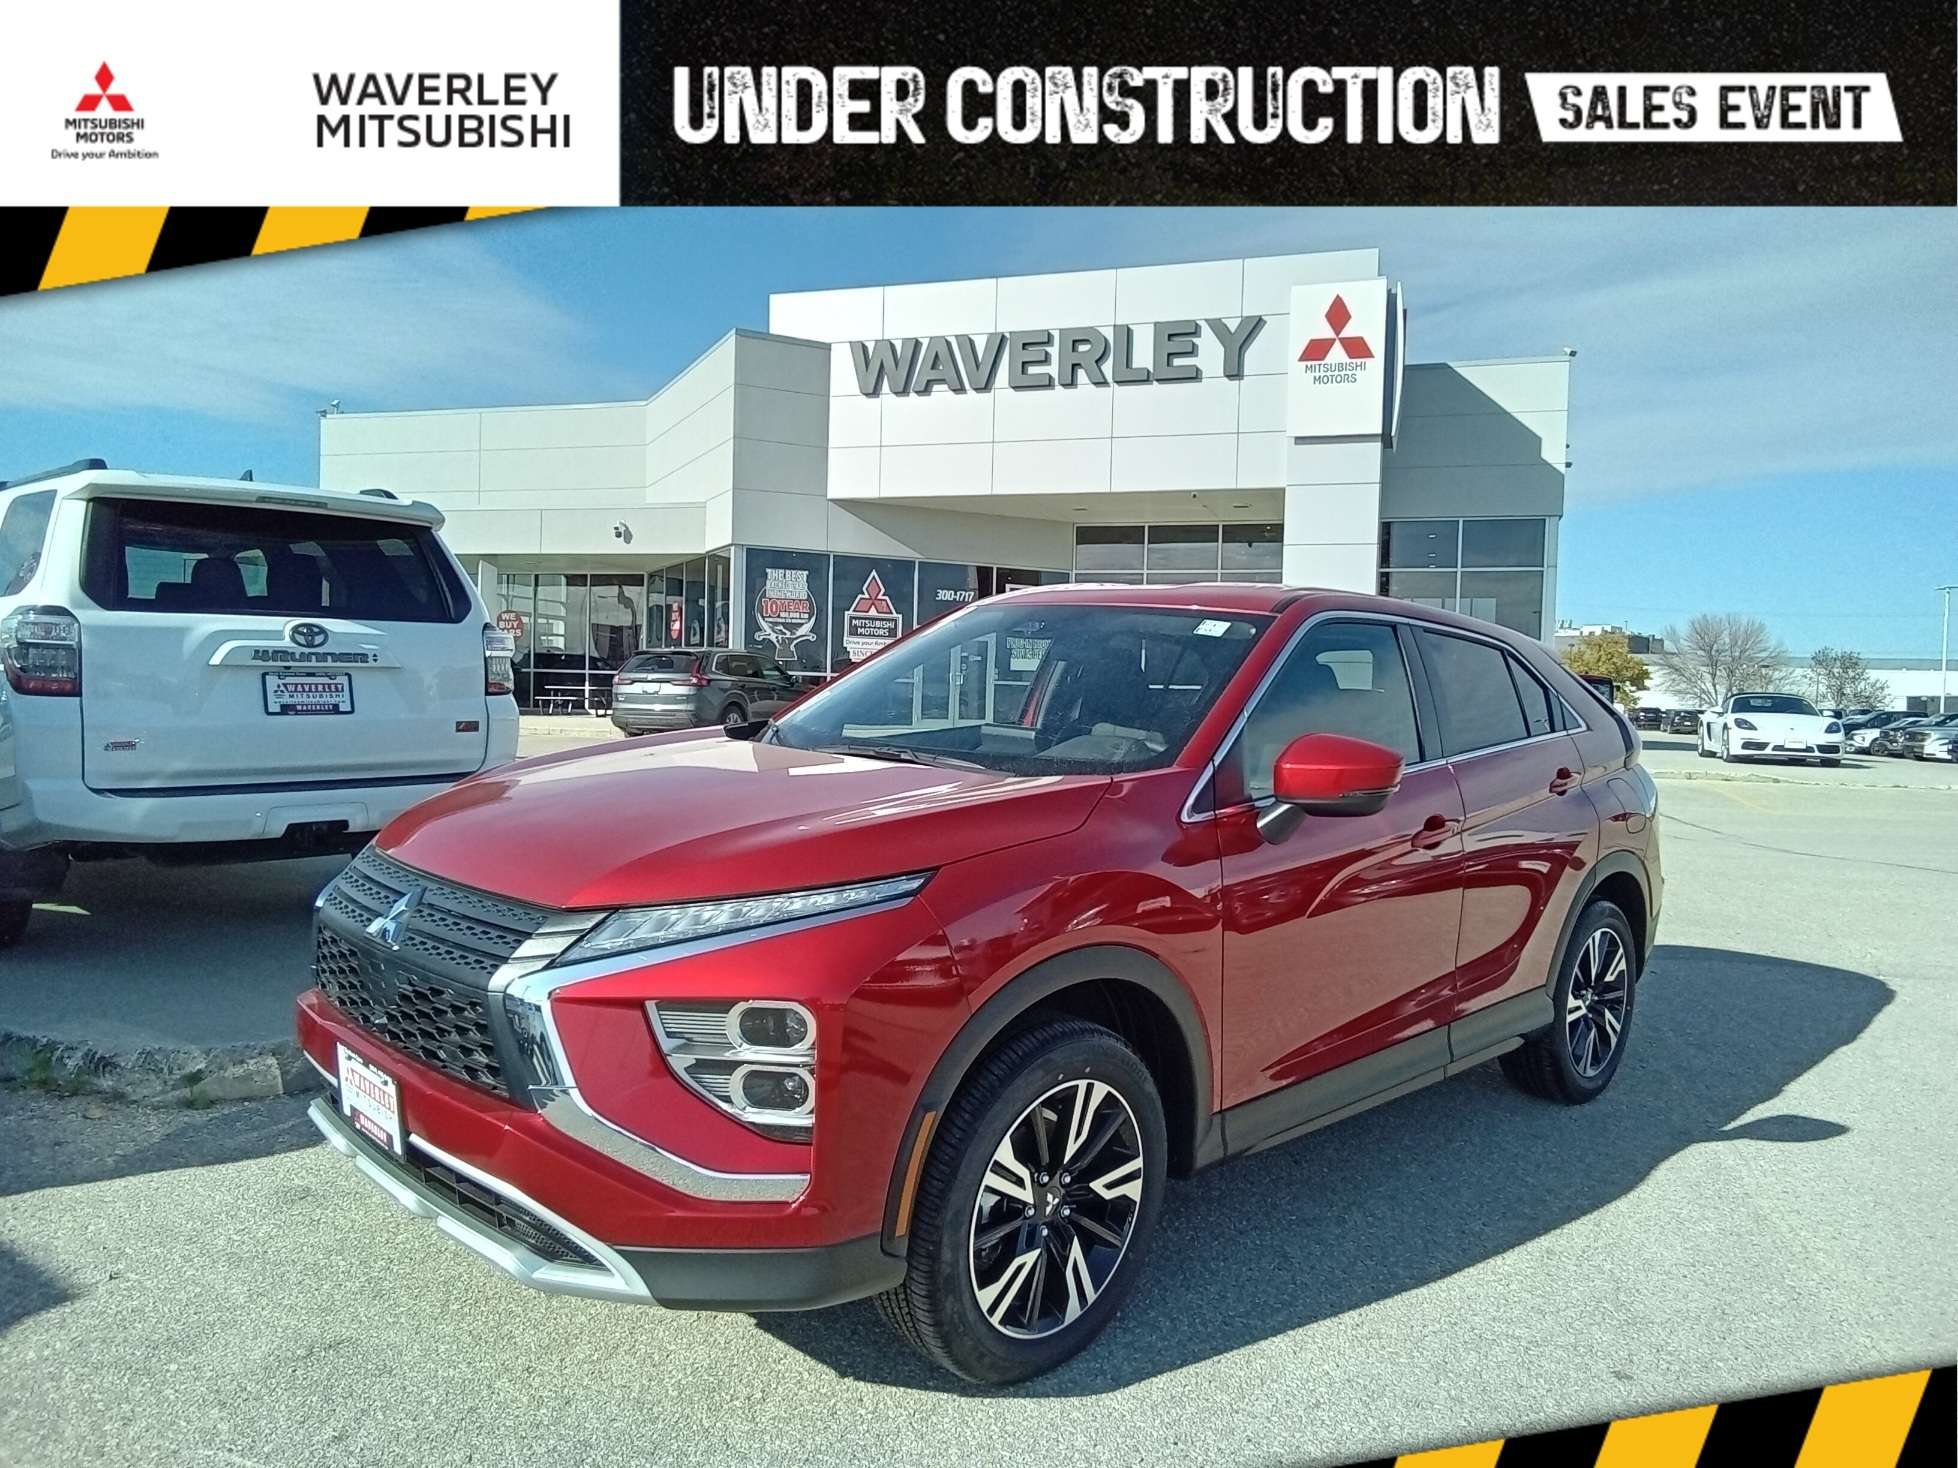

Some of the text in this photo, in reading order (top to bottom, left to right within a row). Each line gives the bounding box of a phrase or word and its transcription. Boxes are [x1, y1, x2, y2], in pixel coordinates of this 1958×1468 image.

[849, 316, 1267, 397] WAVERLEY
[1305, 361, 1366, 373] MITSUBISHI
[1313, 373, 1357, 385] MOTORS
[766, 568, 809, 581] THE BEST
[936, 589, 974, 602] 300-1717
[762, 599, 779, 617] 10
[778, 600, 810, 612] YEAR
[498, 620, 519, 629] BUY
[852, 619, 895, 628] MITSUBISHI
[500, 628, 521, 636] RS
[857, 627, 889, 636] MOTORS
[286, 684, 344, 692] WAVERLEY
